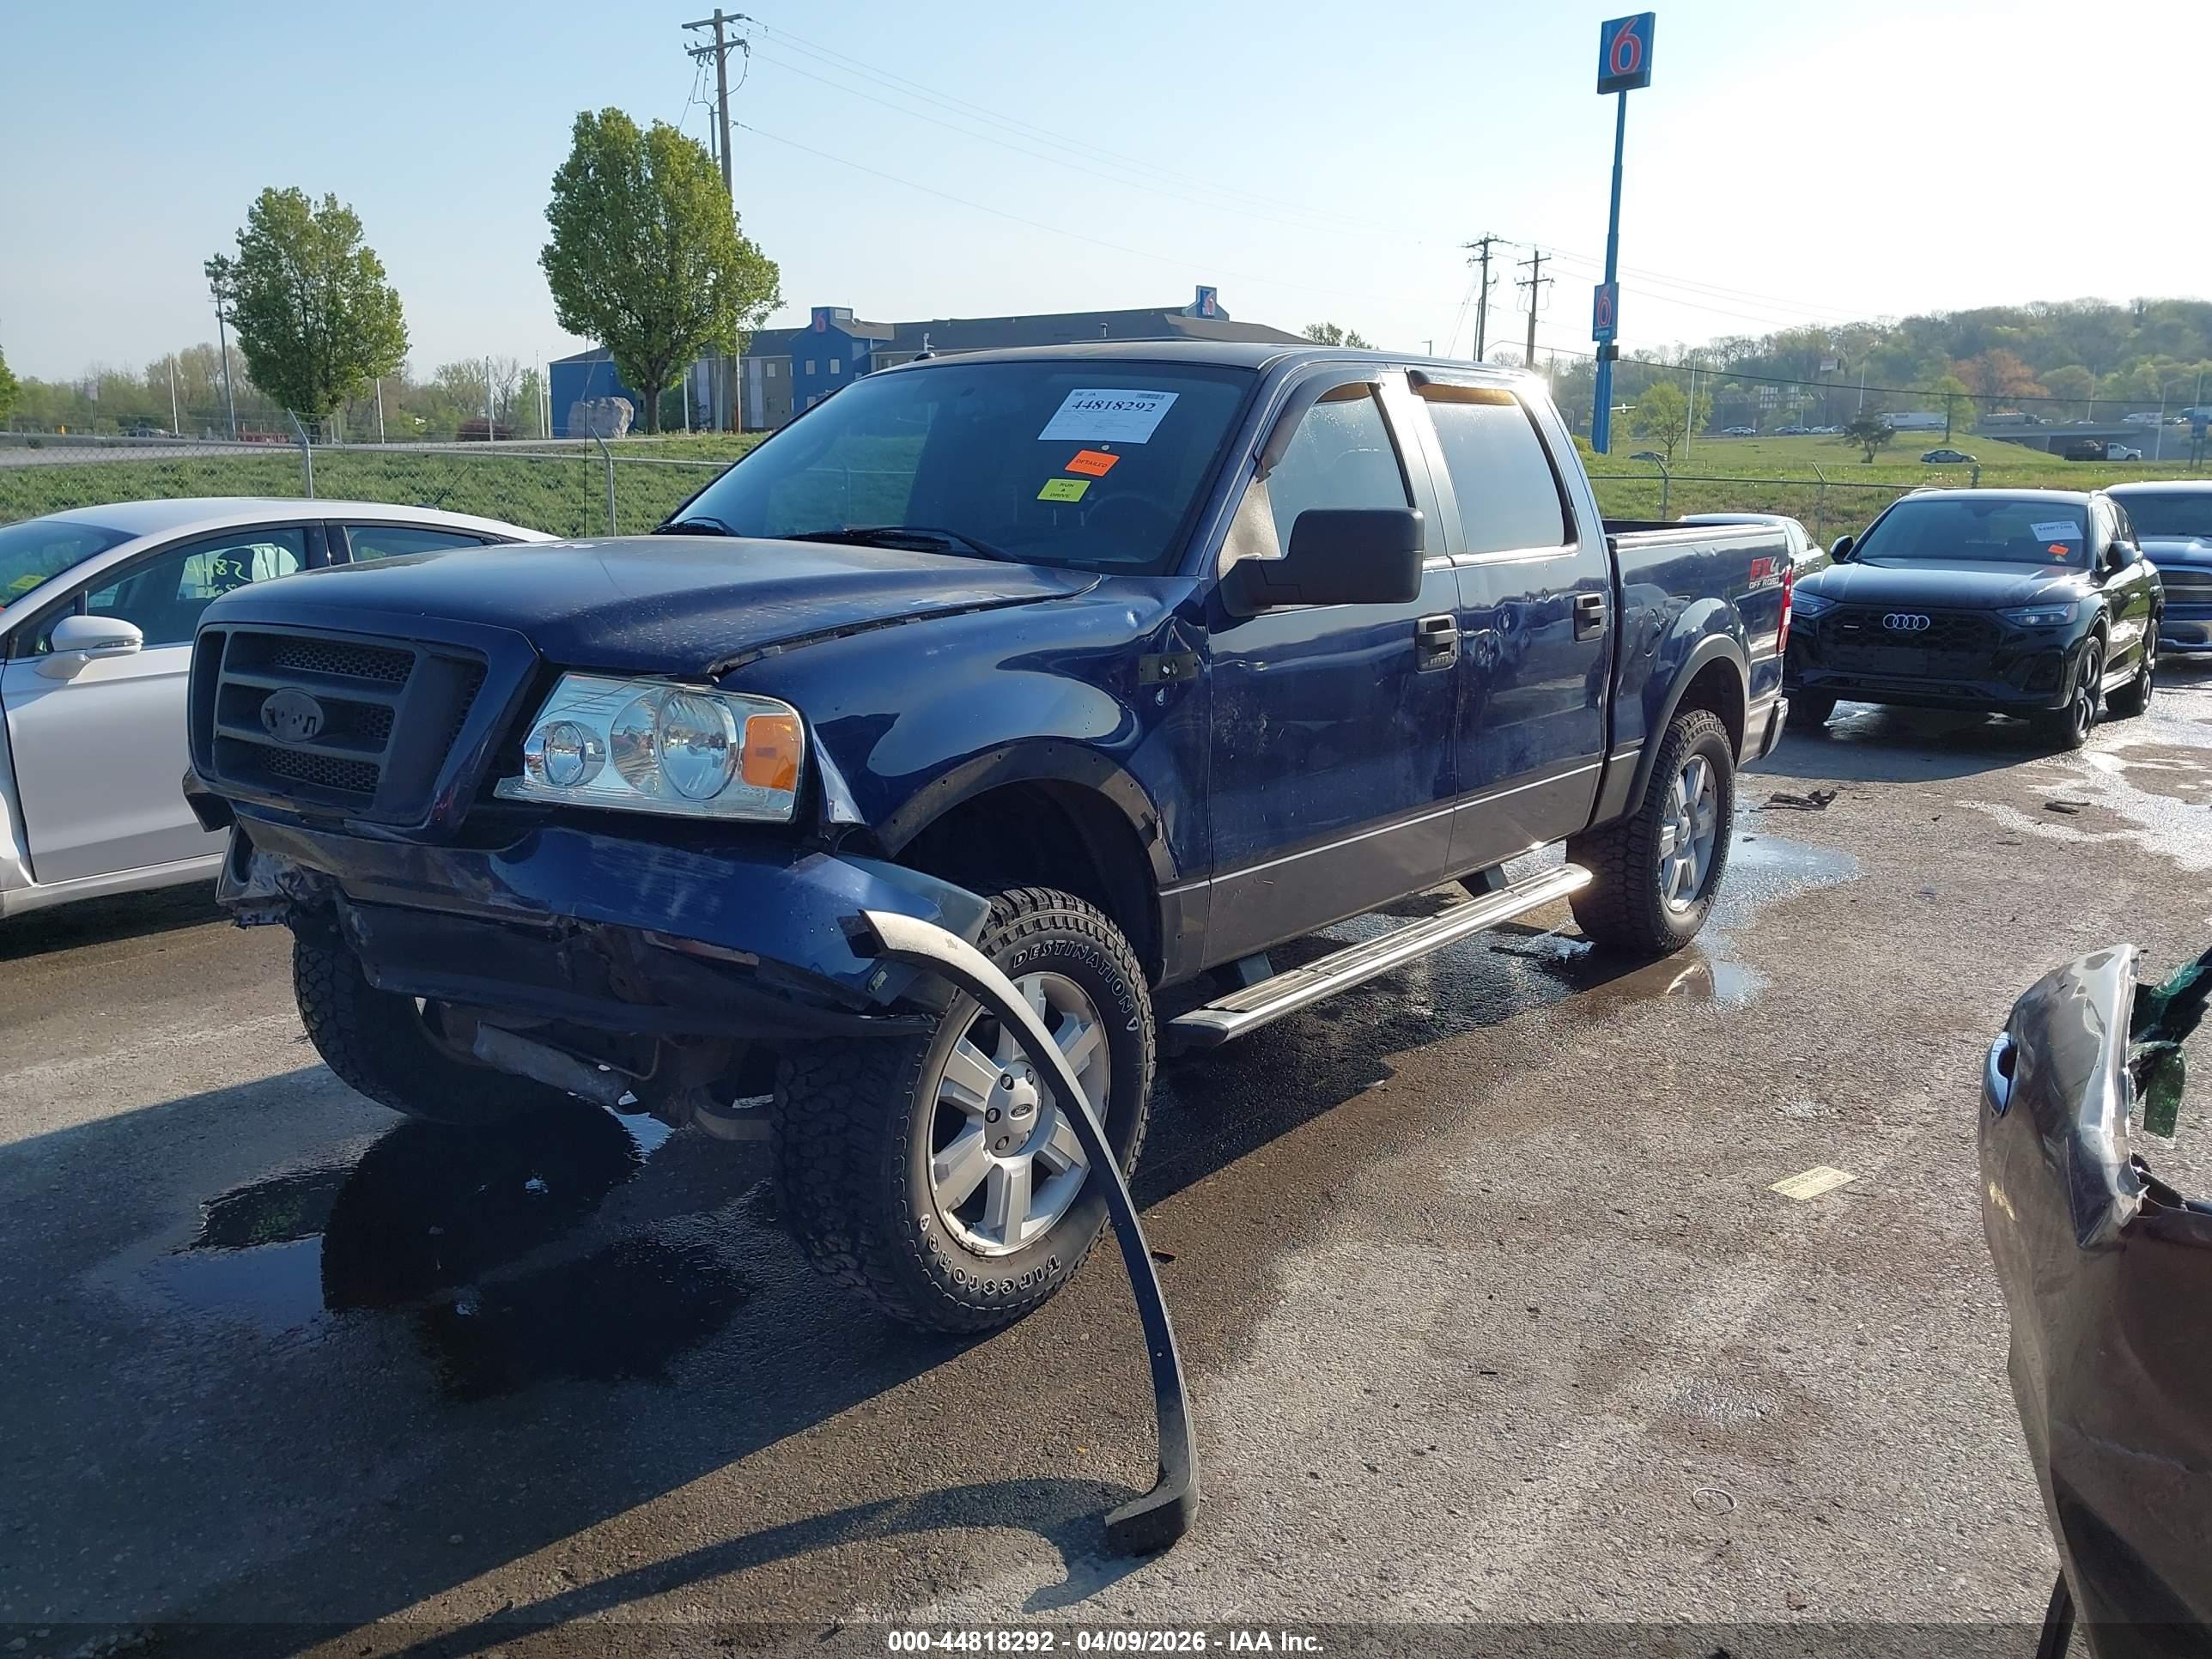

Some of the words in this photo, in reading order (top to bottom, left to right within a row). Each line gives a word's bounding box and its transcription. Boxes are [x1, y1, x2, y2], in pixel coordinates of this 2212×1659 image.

[1609, 16, 1642, 76] 6
[1597, 284, 1612, 328] 6
[1072, 399, 1157, 412] 44818292
[1749, 580, 1761, 589] OFF
[1763, 577, 1779, 587] ROAD
[1012, 940, 1133, 1013] DESTINATION
[929, 1233, 1061, 1295] Firestone
